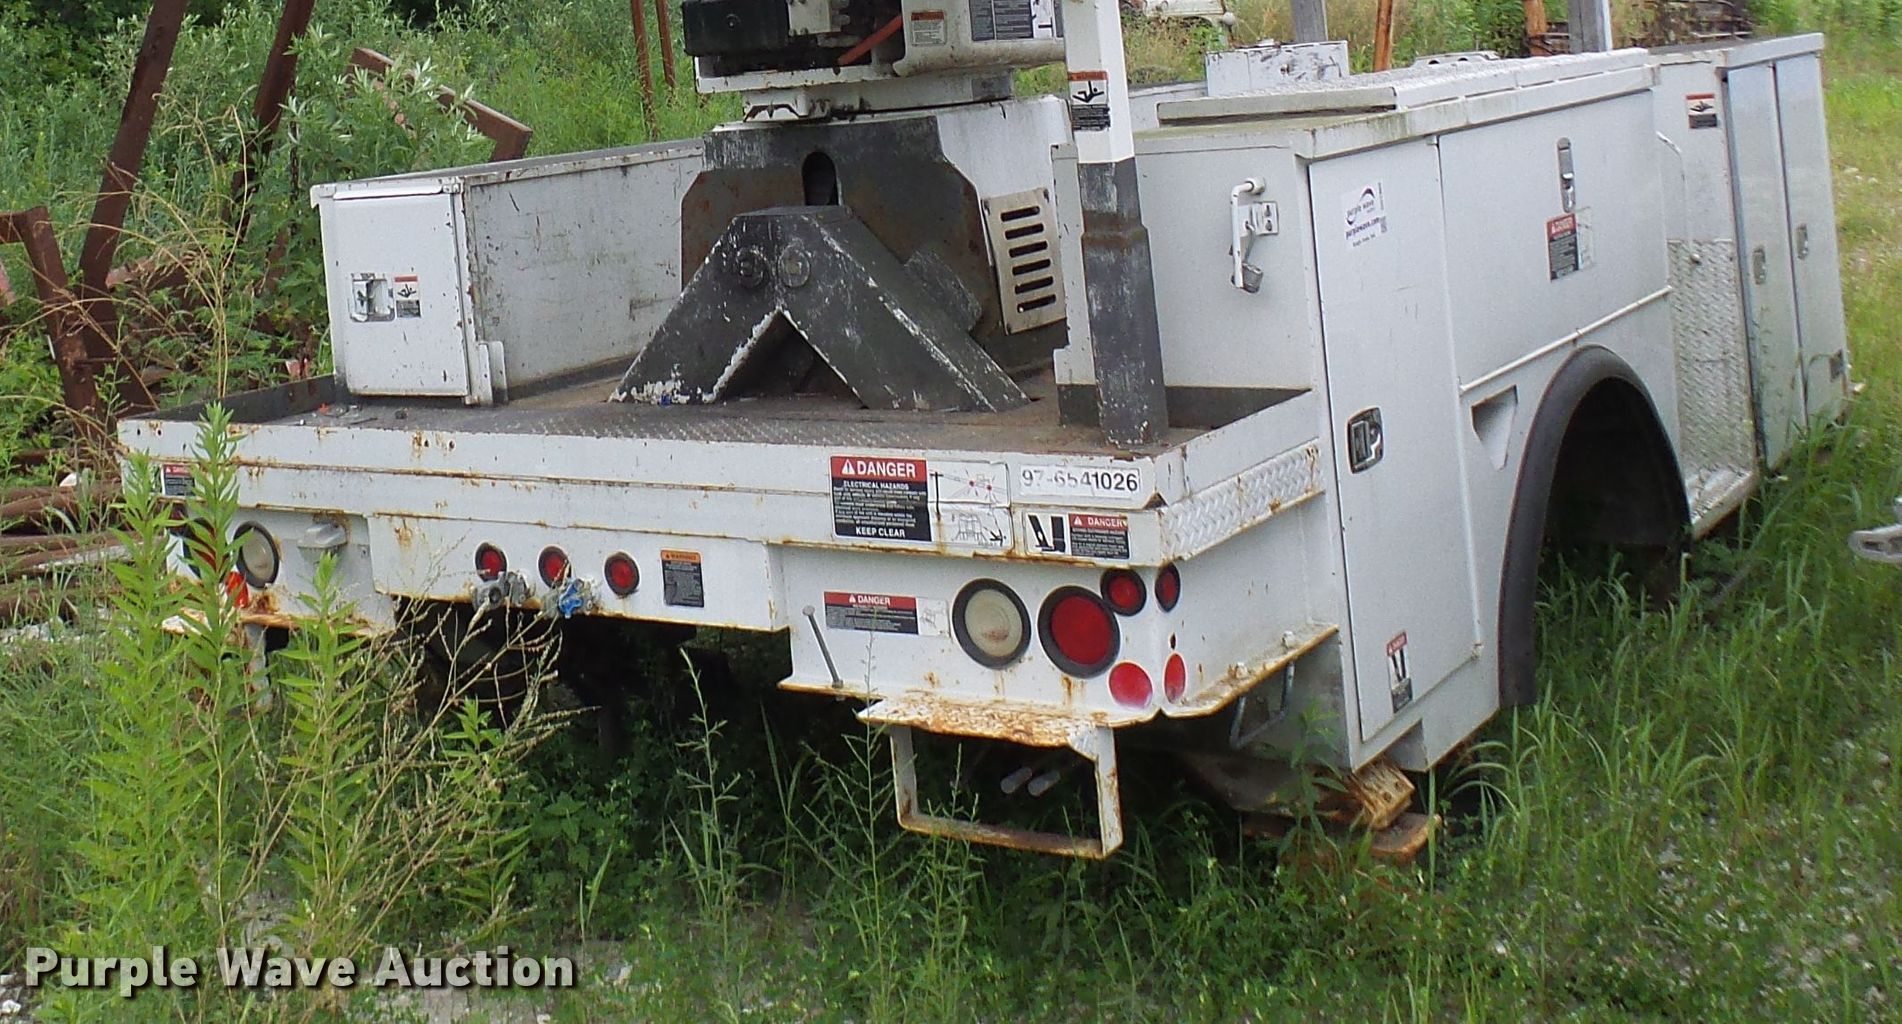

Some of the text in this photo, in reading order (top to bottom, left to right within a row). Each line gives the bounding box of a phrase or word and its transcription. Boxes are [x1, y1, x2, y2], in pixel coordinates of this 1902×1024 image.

[857, 461, 916, 478] DANGER
[843, 480, 910, 491] ELECTRICAL HAZARDS
[1087, 518, 1123, 527] DANGER
[855, 526, 906, 538] KEEP CLEAR
[857, 595, 891, 606] DANGER
